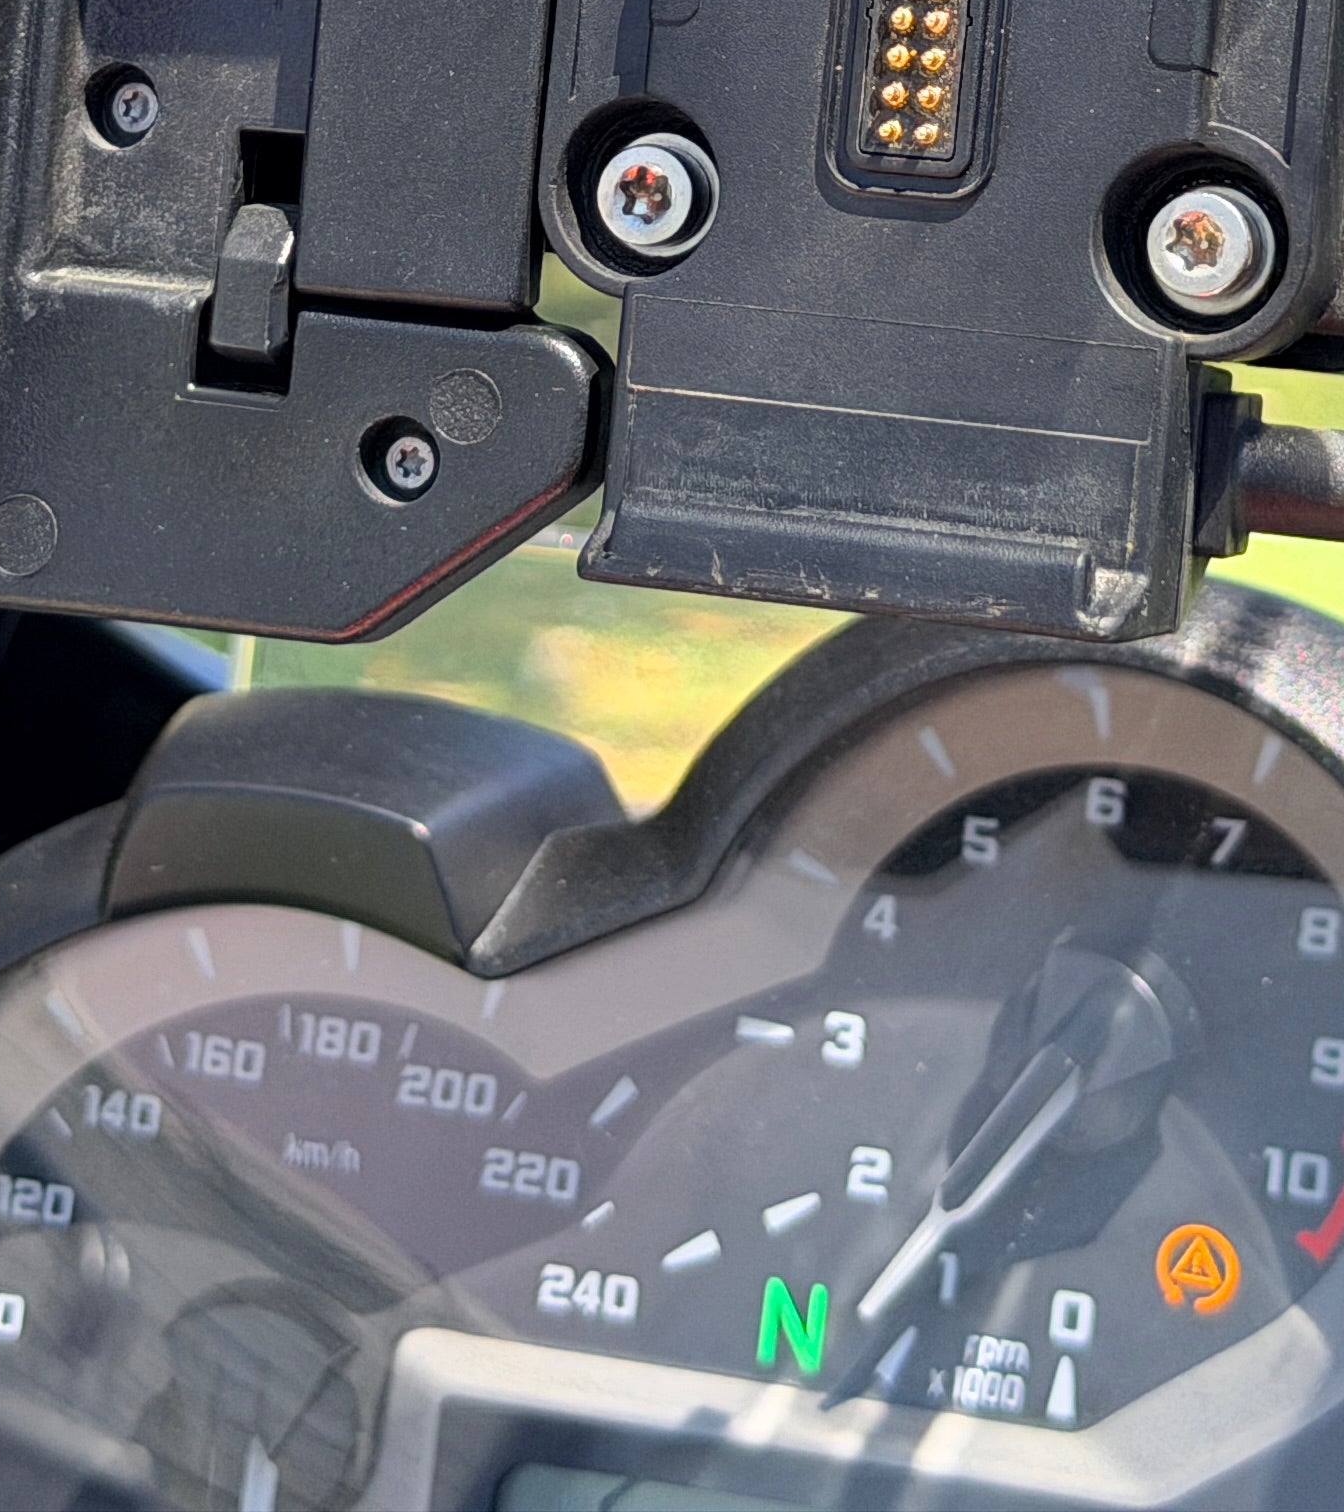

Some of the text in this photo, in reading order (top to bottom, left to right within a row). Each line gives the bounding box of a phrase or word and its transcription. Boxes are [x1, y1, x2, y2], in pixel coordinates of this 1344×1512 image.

[1086, 777, 1126, 826] 6
[962, 815, 999, 865] 5
[1211, 817, 1247, 866] 7
[863, 895, 897, 940] 4
[1298, 907, 1341, 956] 8
[185, 1031, 266, 1084] 160
[299, 1013, 381, 1065] 180
[822, 1010, 865, 1067] 3
[83, 1084, 161, 1138] 140
[397, 1064, 498, 1118] 200
[283, 1132, 361, 1175] km/h
[480, 1147, 580, 1204] 220
[847, 1146, 892, 1206] 2
[1263, 1145, 1330, 1203] 10
[537, 1263, 639, 1324] 240
[938, 1251, 959, 1307] 1
[757, 1276, 829, 1373] N
[1049, 1289, 1096, 1348] 0
[963, 1334, 1030, 1375] rpm
